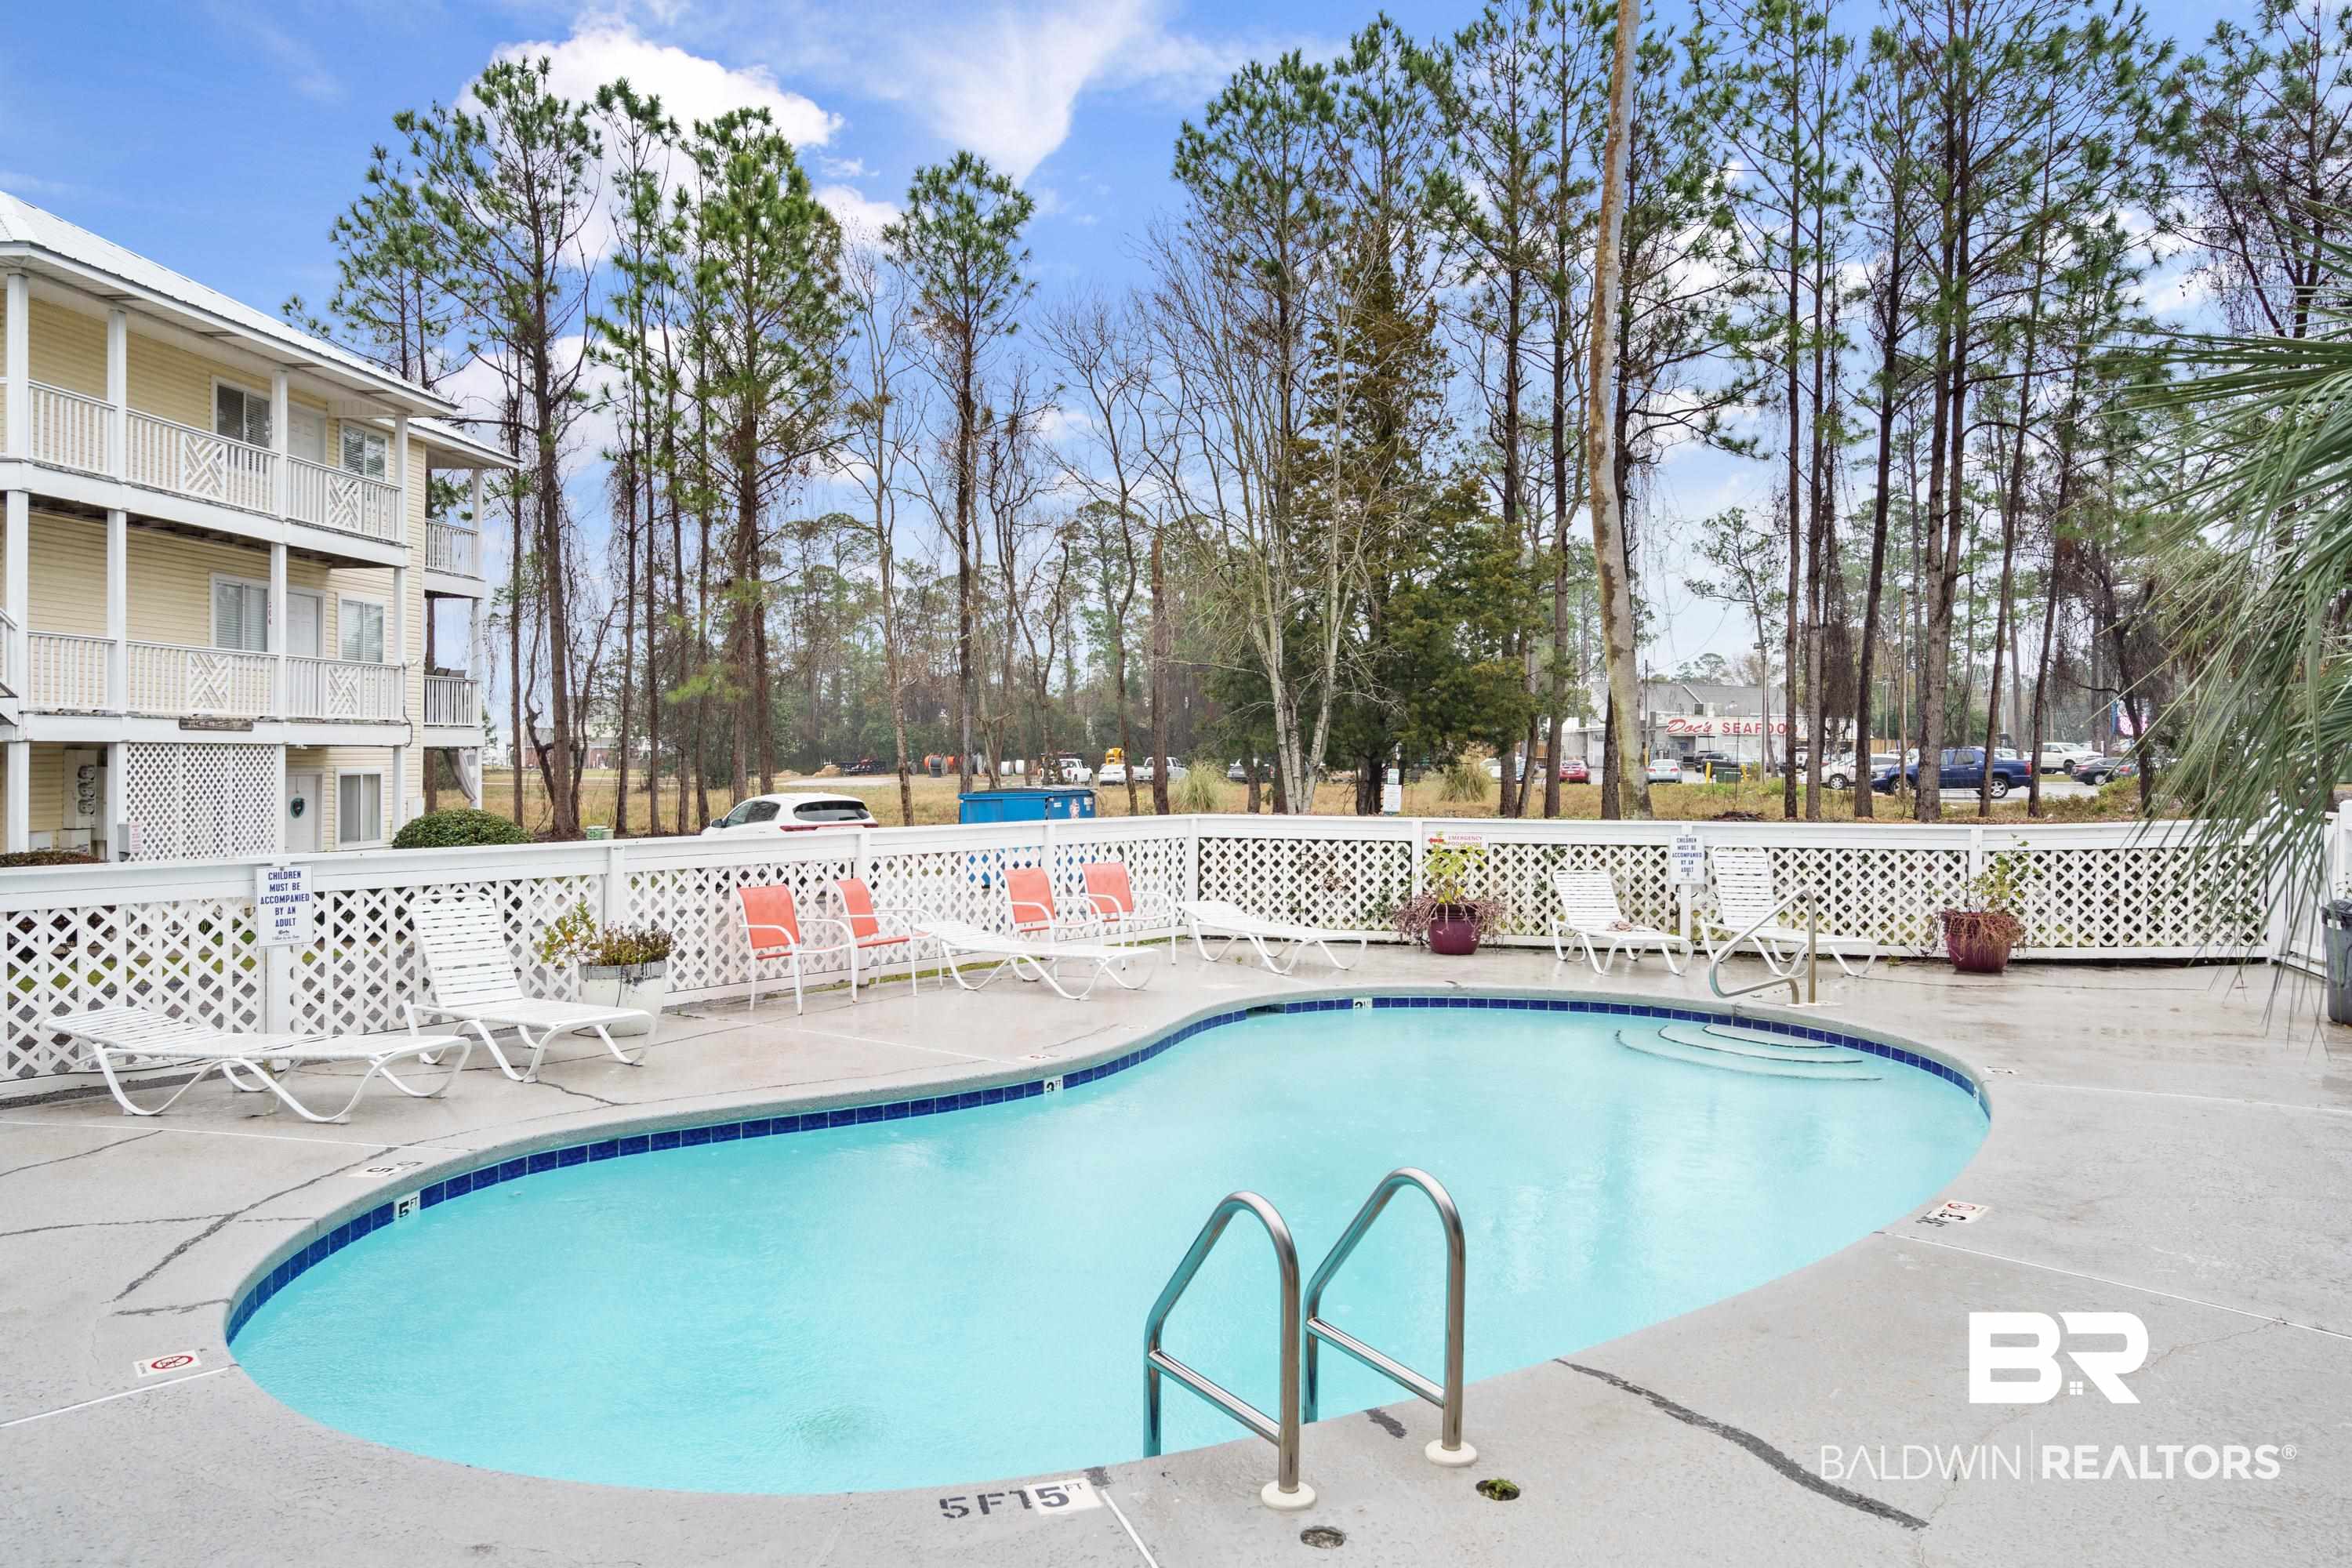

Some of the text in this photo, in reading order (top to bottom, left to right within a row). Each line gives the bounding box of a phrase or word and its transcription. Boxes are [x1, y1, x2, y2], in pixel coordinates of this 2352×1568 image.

[1665, 718, 1798, 734] Doc's SEAFOO
[268, 871, 301, 880] CHILDREN
[269, 882, 301, 892] MUST BE
[260, 893, 310, 905] ACCOMPANIED
[274, 906, 296, 916] BY AN
[275, 918, 296, 927] ADULT
[398, 1196, 418, 1218] 5 FT
[1034, 1482, 1083, 1508] 5 FT
